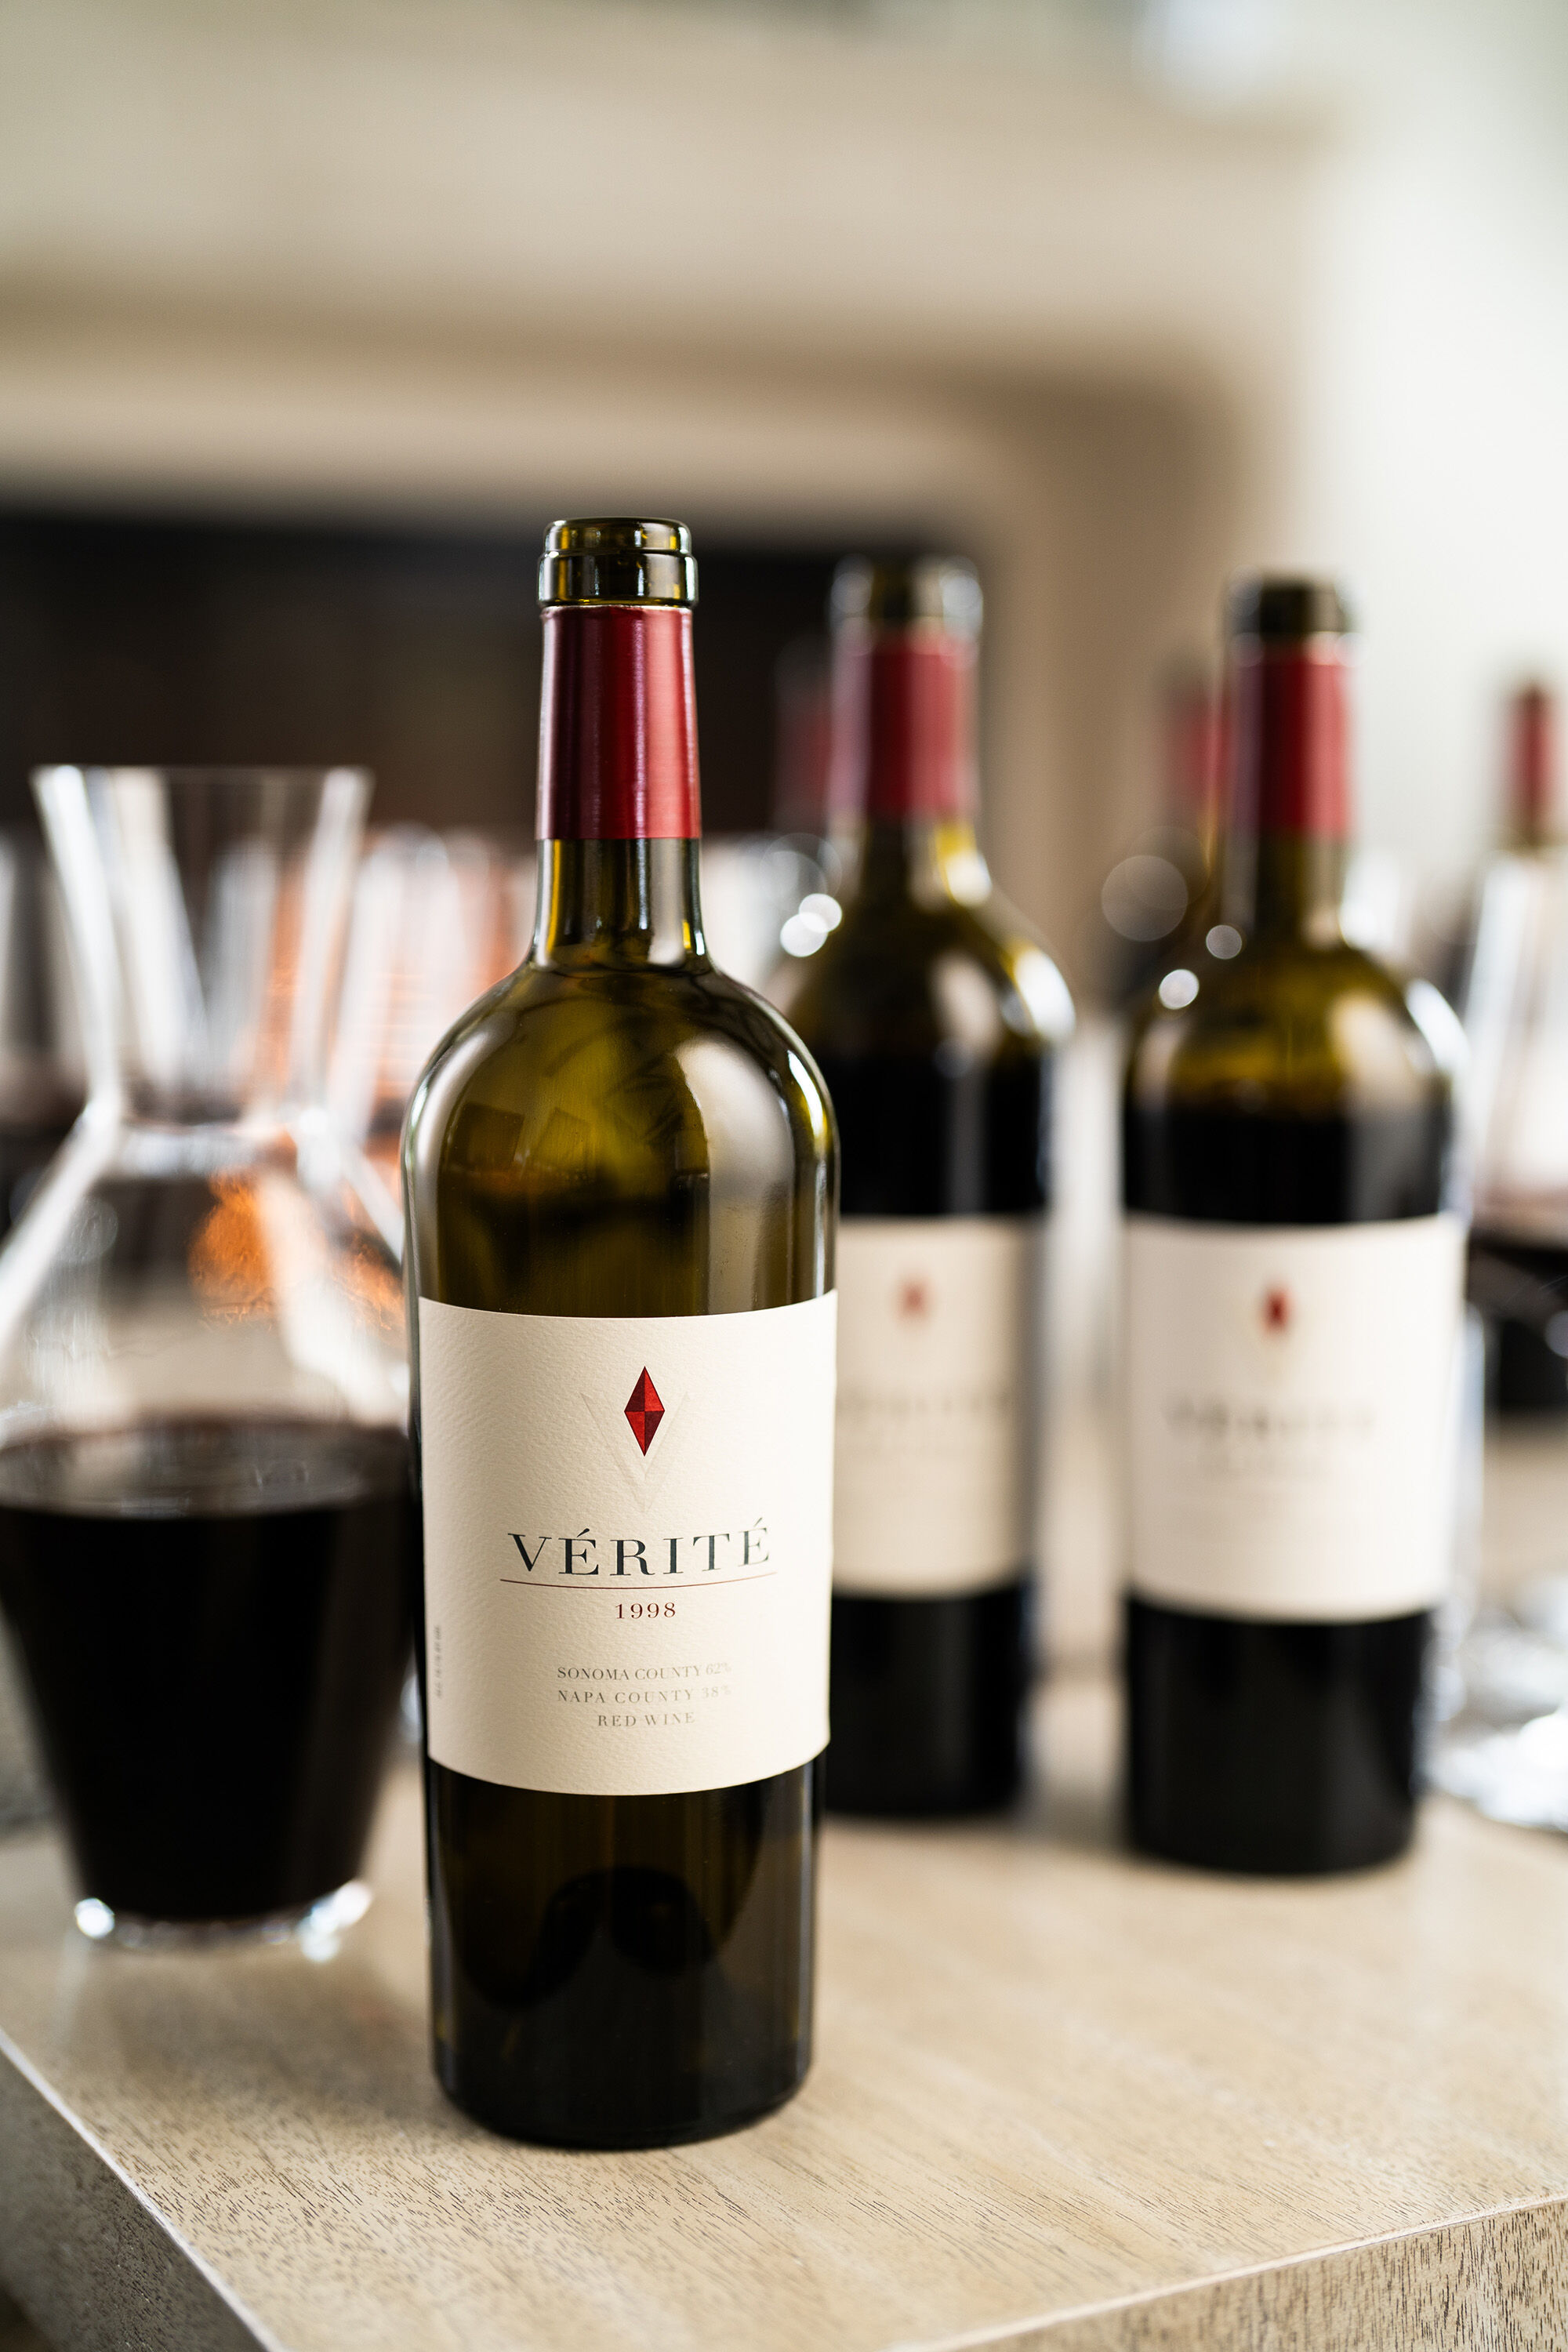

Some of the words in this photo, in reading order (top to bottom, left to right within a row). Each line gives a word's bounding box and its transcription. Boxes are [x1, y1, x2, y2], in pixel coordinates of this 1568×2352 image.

[507, 1517, 770, 1576] VÉRITÉ
[615, 1602, 677, 1620] 1998
[557, 1666, 630, 1681] SONOMA
[634, 1665, 701, 1681] COUNTY
[557, 1690, 606, 1704] NAPA
[615, 1689, 693, 1704] COUNTY
[597, 1714, 637, 1727] RED
[644, 1711, 695, 1726] WINE
